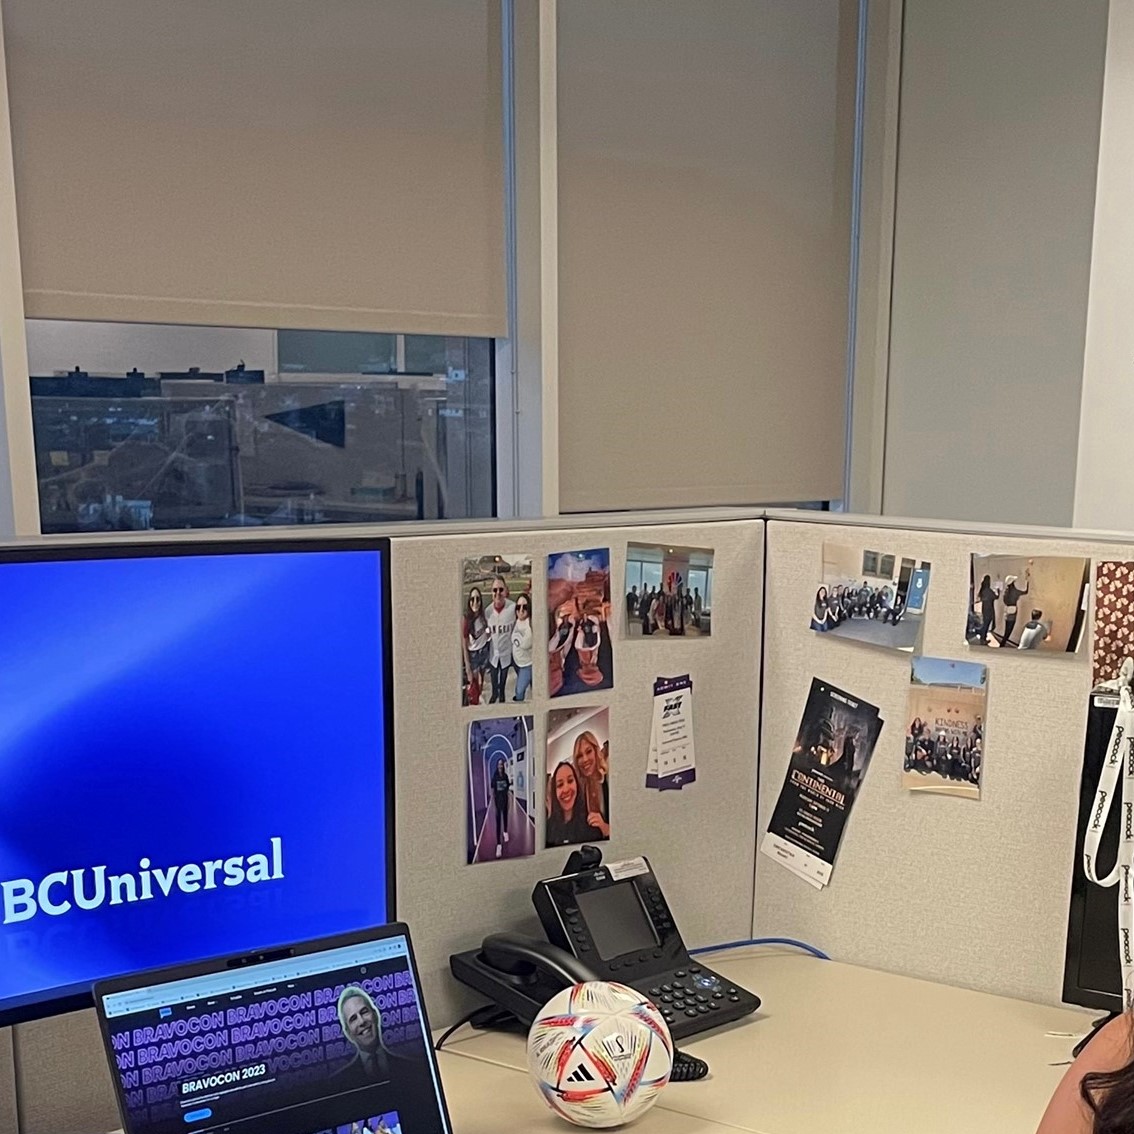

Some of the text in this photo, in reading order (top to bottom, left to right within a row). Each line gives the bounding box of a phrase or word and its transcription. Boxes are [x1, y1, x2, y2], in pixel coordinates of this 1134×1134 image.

[663, 702, 682, 712] FAST
[1109, 725, 1125, 766] peacock
[791, 769, 846, 805] CONTINENTAL
[1091, 790, 1108, 830] peacock
[1124, 801, 1134, 840] peacock
[1, 837, 284, 925] BCUniversal
[1120, 928, 1133, 965] peacock
[133, 1011, 224, 1046] BRAVOCON
[227, 991, 311, 1027] BRAVOCON
[138, 1030, 228, 1066] BRAVOCON
[231, 1009, 316, 1045] BRAVOCON
[142, 1048, 233, 1085] BRAVOCON
[235, 1027, 321, 1063] BRAVOCON
[182, 1071, 240, 1094] BRAVOCON
[241, 1063, 266, 1080] 2023
